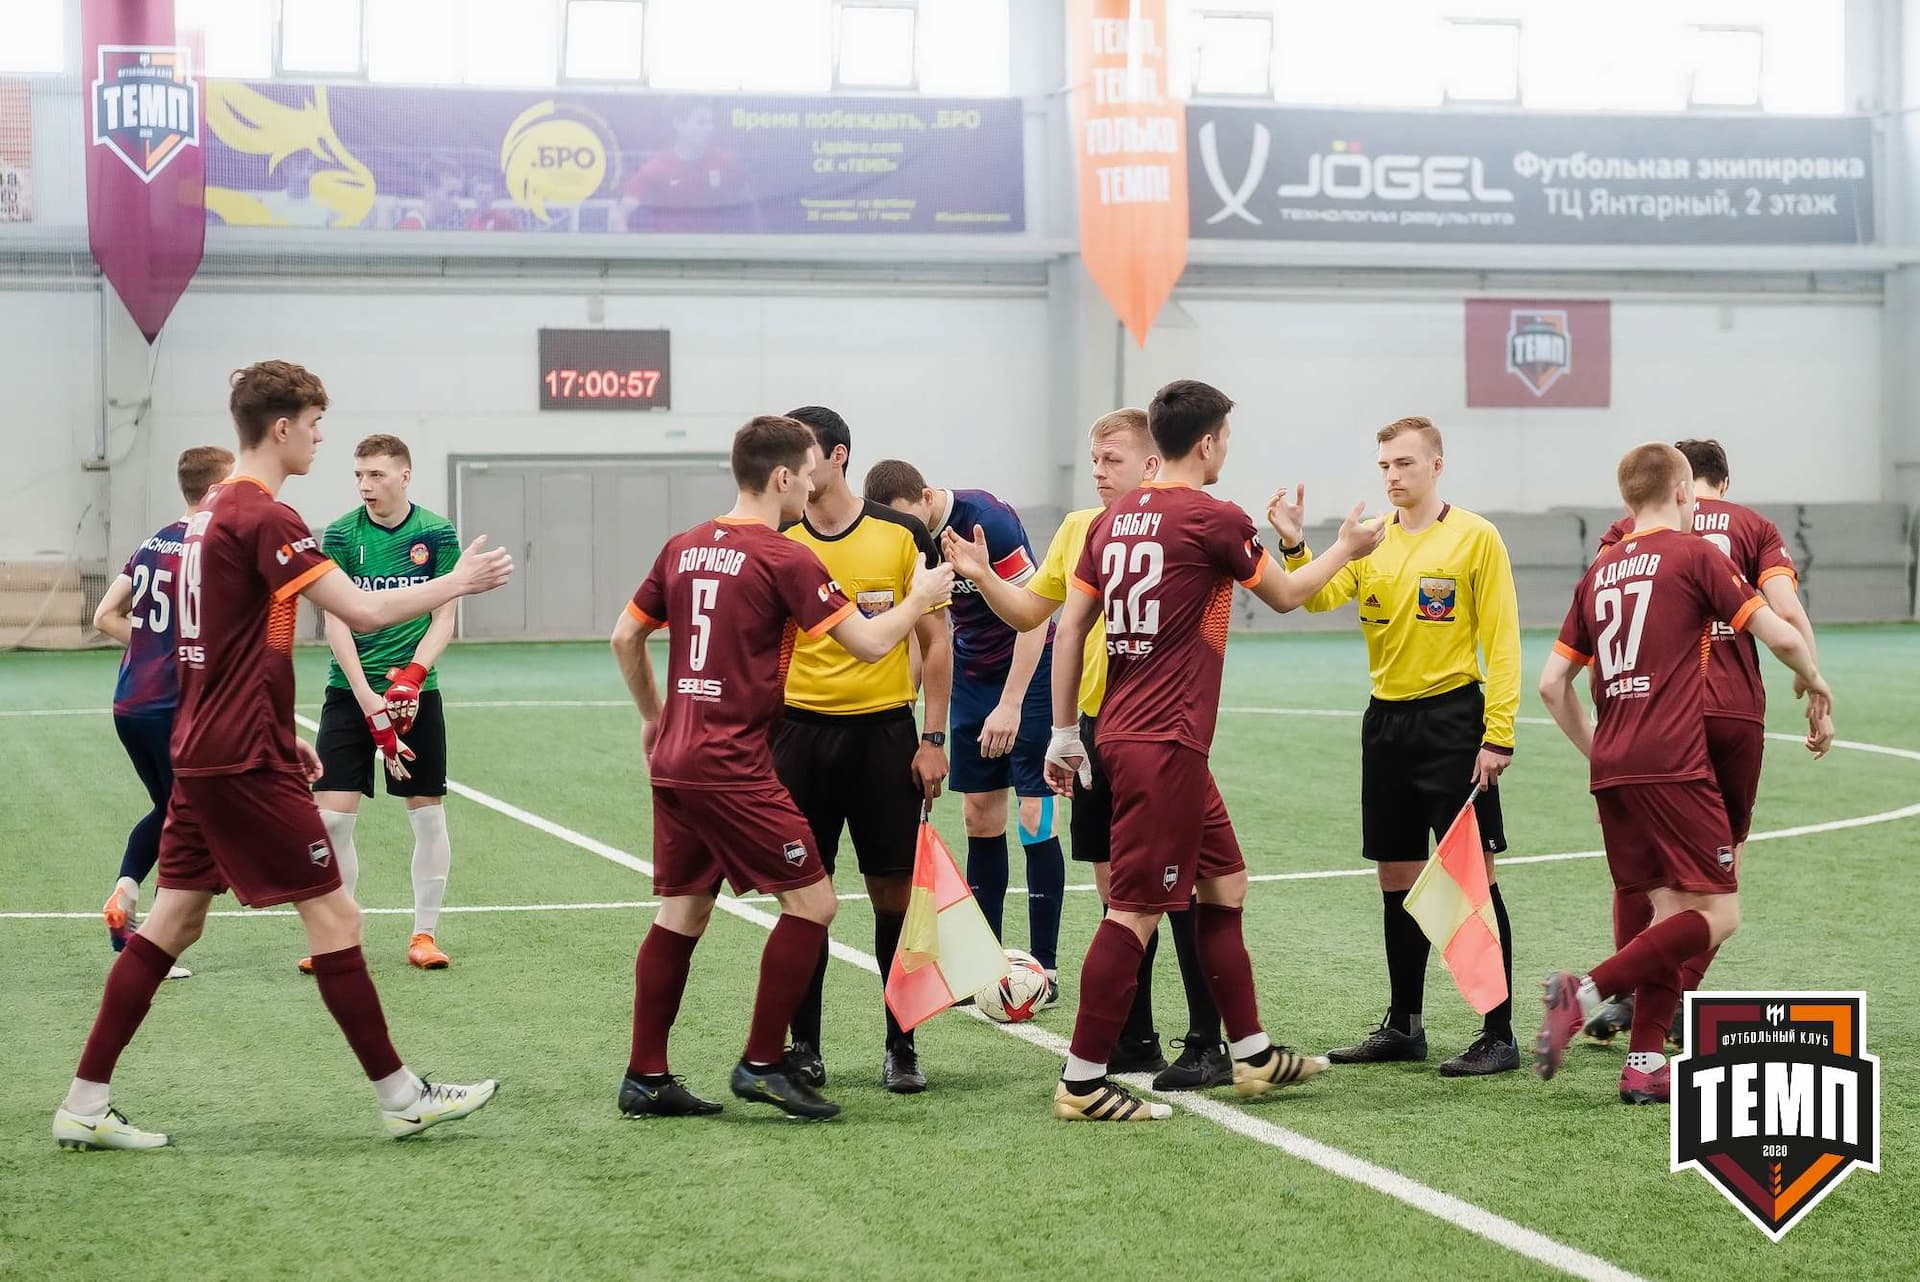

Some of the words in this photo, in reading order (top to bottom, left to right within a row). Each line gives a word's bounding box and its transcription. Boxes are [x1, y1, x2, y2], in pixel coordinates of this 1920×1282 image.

[103, 83, 188, 132] ТЕМП
[531, 146, 596, 169] .БРО
[1512, 151, 1690, 184] Футбольная
[1697, 157, 1866, 185] экипировка
[1543, 188, 1584, 220] ТЦ
[1589, 187, 1738, 221] Янтарный,
[1745, 188, 1762, 217] 2
[1769, 194, 1838, 217] этаж
[544, 369, 662, 399] 17:00:57
[1111, 513, 1163, 537] БАБИЧ
[678, 547, 746, 577] БОРИСОВ
[131, 564, 172, 634] 25
[1101, 541, 1165, 635] 22
[688, 578, 721, 672] 5
[1594, 580, 1654, 681] 27
